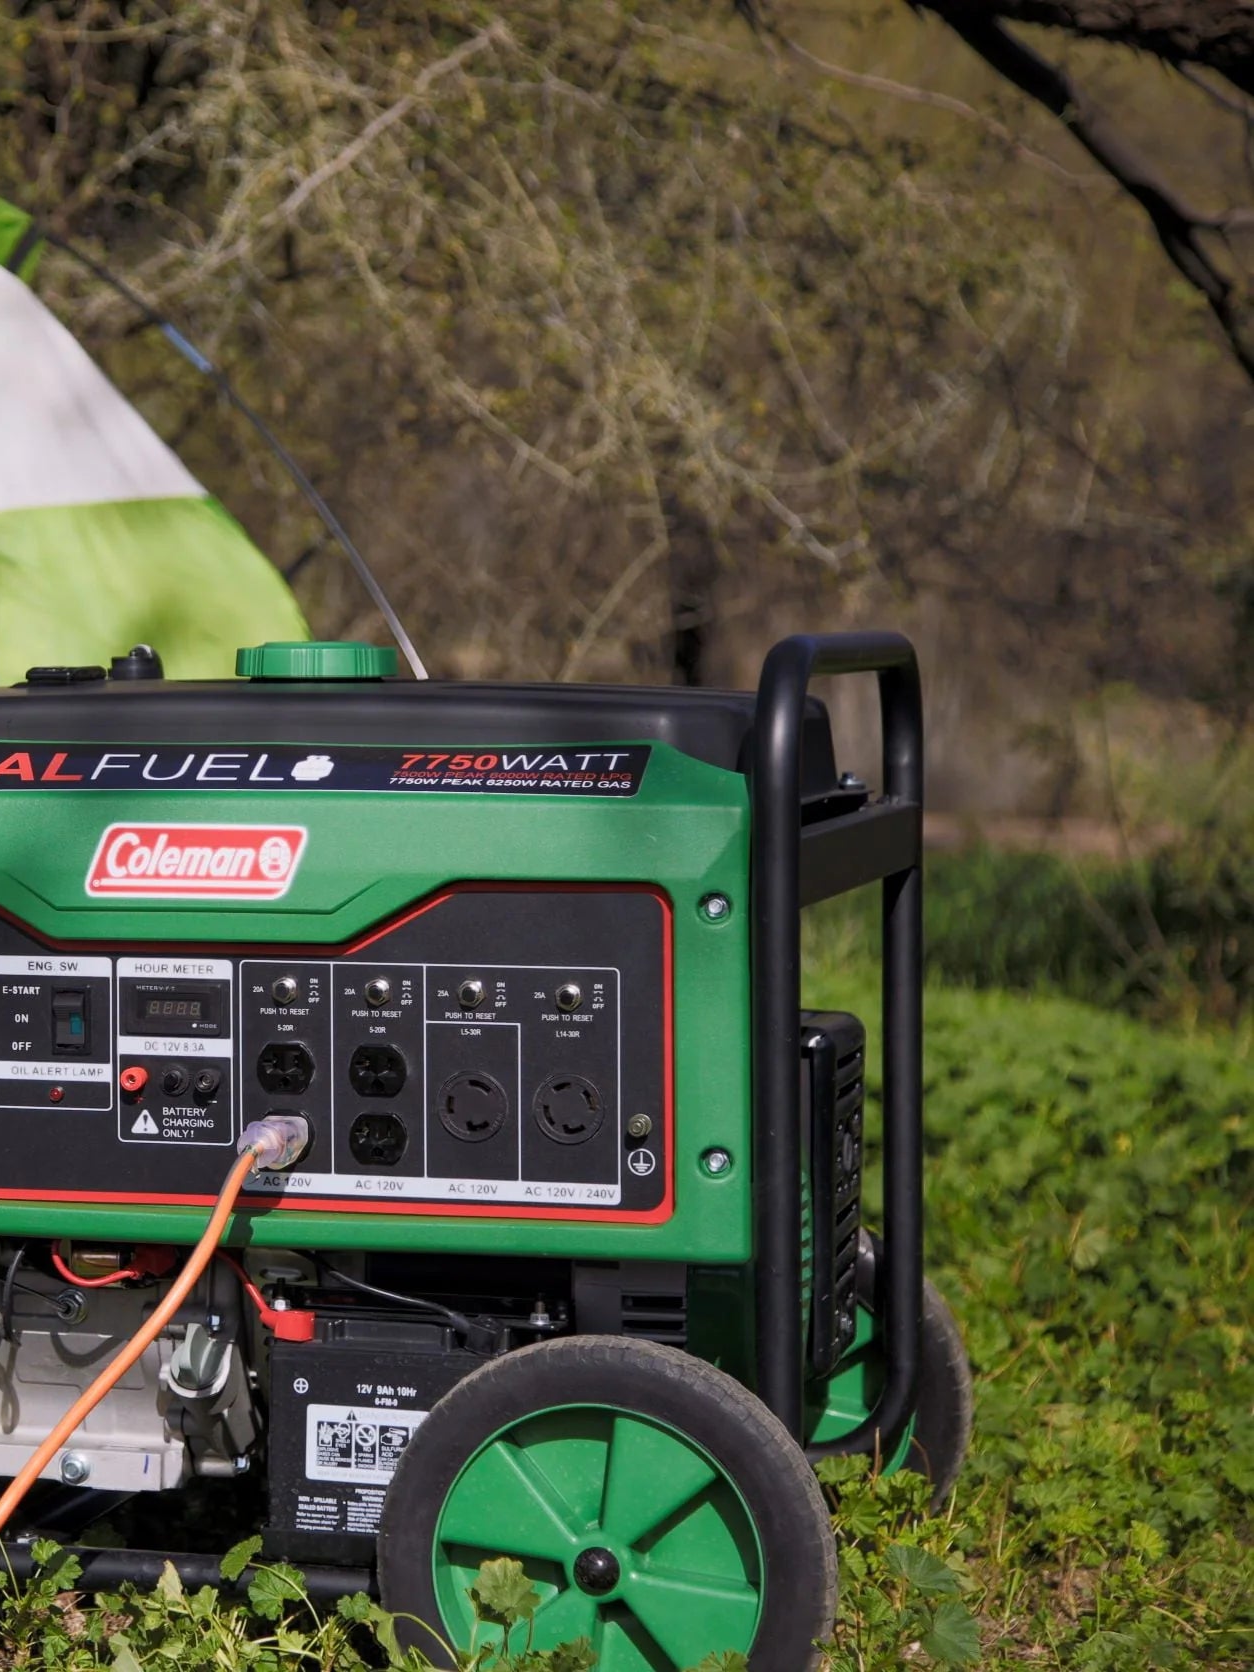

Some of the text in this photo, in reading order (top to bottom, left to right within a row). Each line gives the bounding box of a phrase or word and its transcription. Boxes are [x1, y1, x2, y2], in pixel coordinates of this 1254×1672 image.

[90, 753, 284, 781] FUEL
[445, 771, 484, 779] PEAK
[545, 772, 595, 780] RATED
[600, 772, 632, 781] LPG
[389, 777, 631, 789] 7750W PEAK 6250W RATED GAS
[106, 832, 256, 877] Coleman
[135, 963, 214, 974] HOUR METER
[2, 986, 41, 995] E-START
[14, 1013, 29, 1023] ON
[11, 1041, 32, 1051] OFF
[144, 1041, 158, 1051] DC
[163, 1042, 180, 1051] 12V
[11, 1066, 104, 1077] OIL ALERT LAMP
[162, 1107, 207, 1117] BATTERY
[162, 1118, 214, 1128] CHARGING
[263, 1176, 312, 1187] AC 120V
[355, 1180, 405, 1191] AC 120V
[448, 1183, 498, 1194] AC 120V
[524, 1186, 542, 1196] AC
[356, 1384, 417, 1398] 12V 9Ah 10Hr
